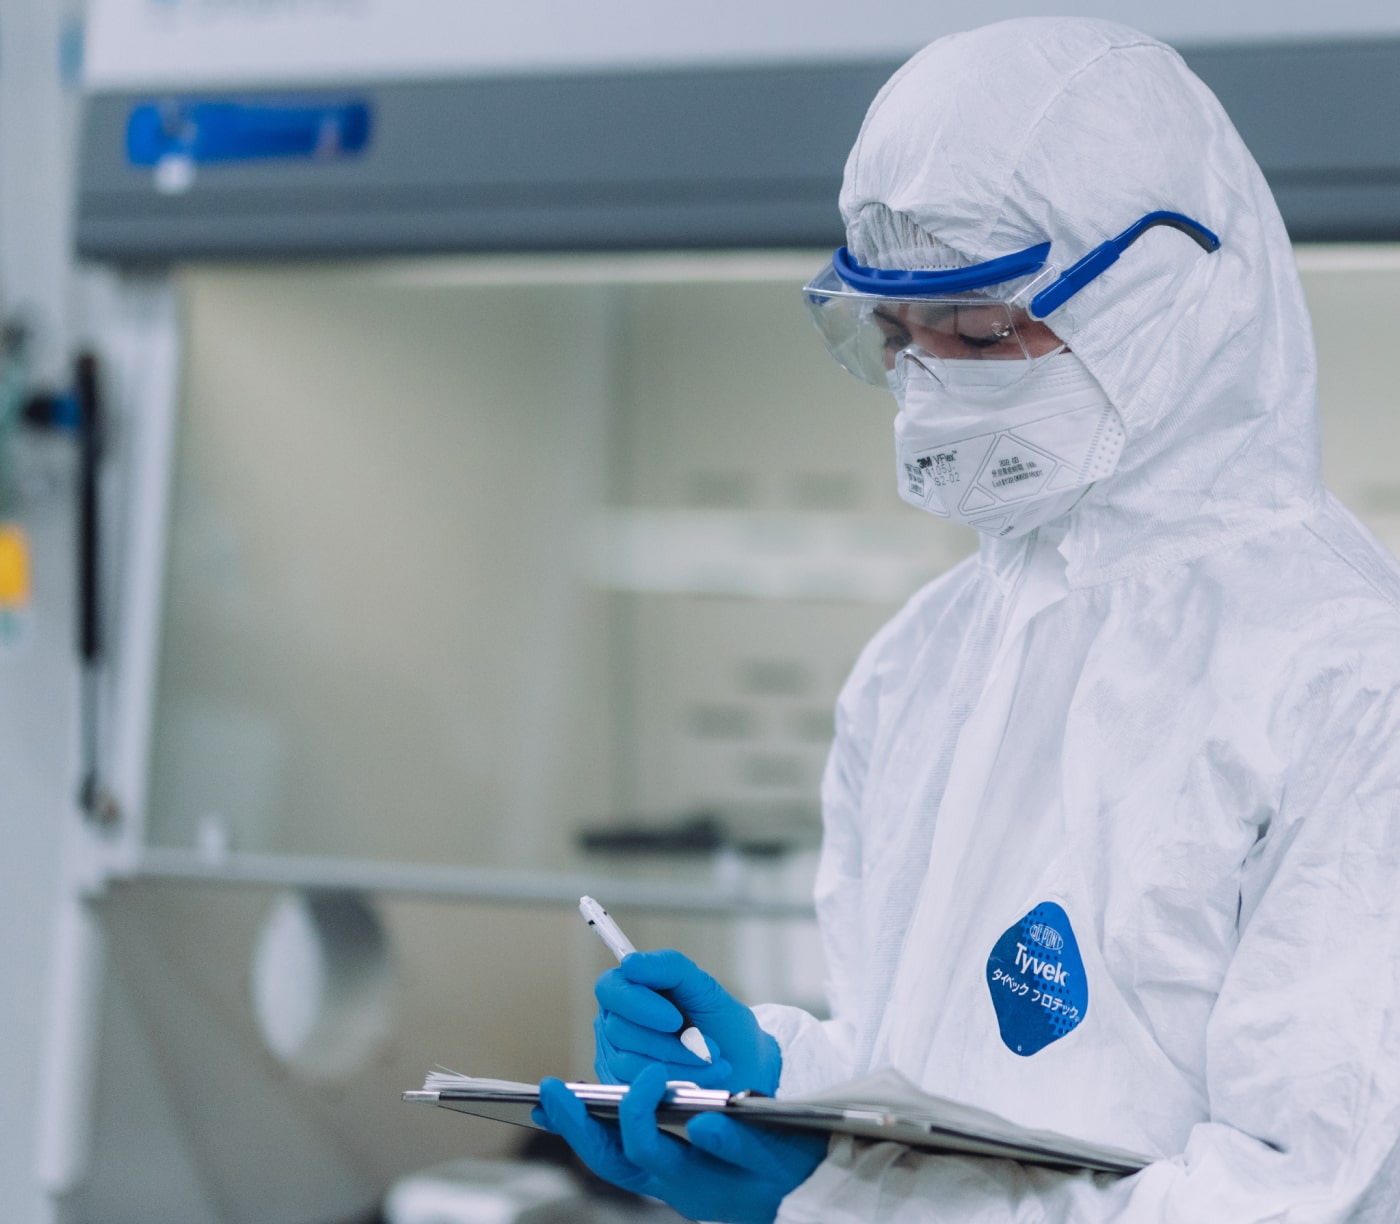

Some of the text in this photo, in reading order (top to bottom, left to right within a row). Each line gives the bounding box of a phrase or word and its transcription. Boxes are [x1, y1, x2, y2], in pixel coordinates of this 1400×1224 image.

[917, 456, 933, 469] 3M
[1015, 942, 1067, 987] Tyvek
[992, 968, 1029, 996] タイベック
